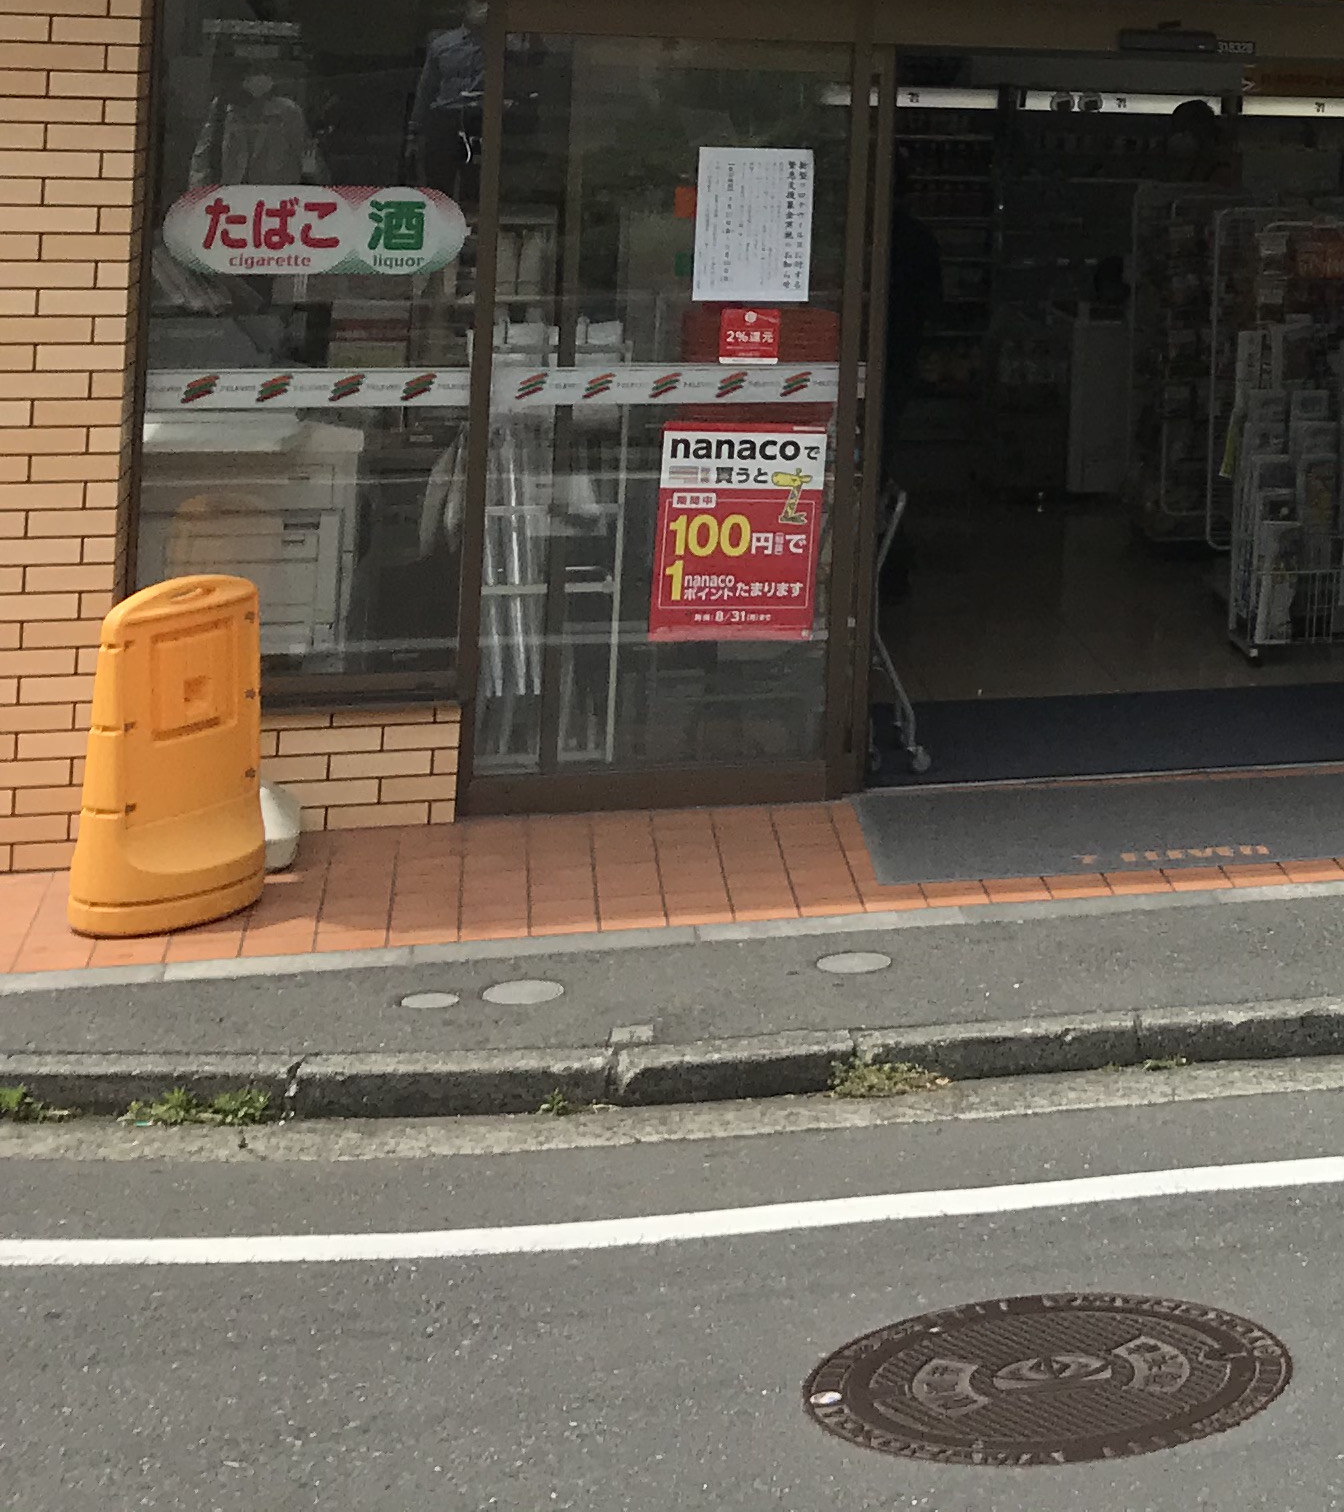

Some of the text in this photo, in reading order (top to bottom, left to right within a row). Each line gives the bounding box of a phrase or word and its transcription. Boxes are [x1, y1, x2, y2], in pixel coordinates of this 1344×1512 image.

[203, 197, 426, 251] たばこ 酒
[228, 251, 425, 271] cigarette liquor
[715, 466, 769, 484] 買うと
[683, 588, 734, 601] ポイント
[736, 582, 804, 598] たまります
